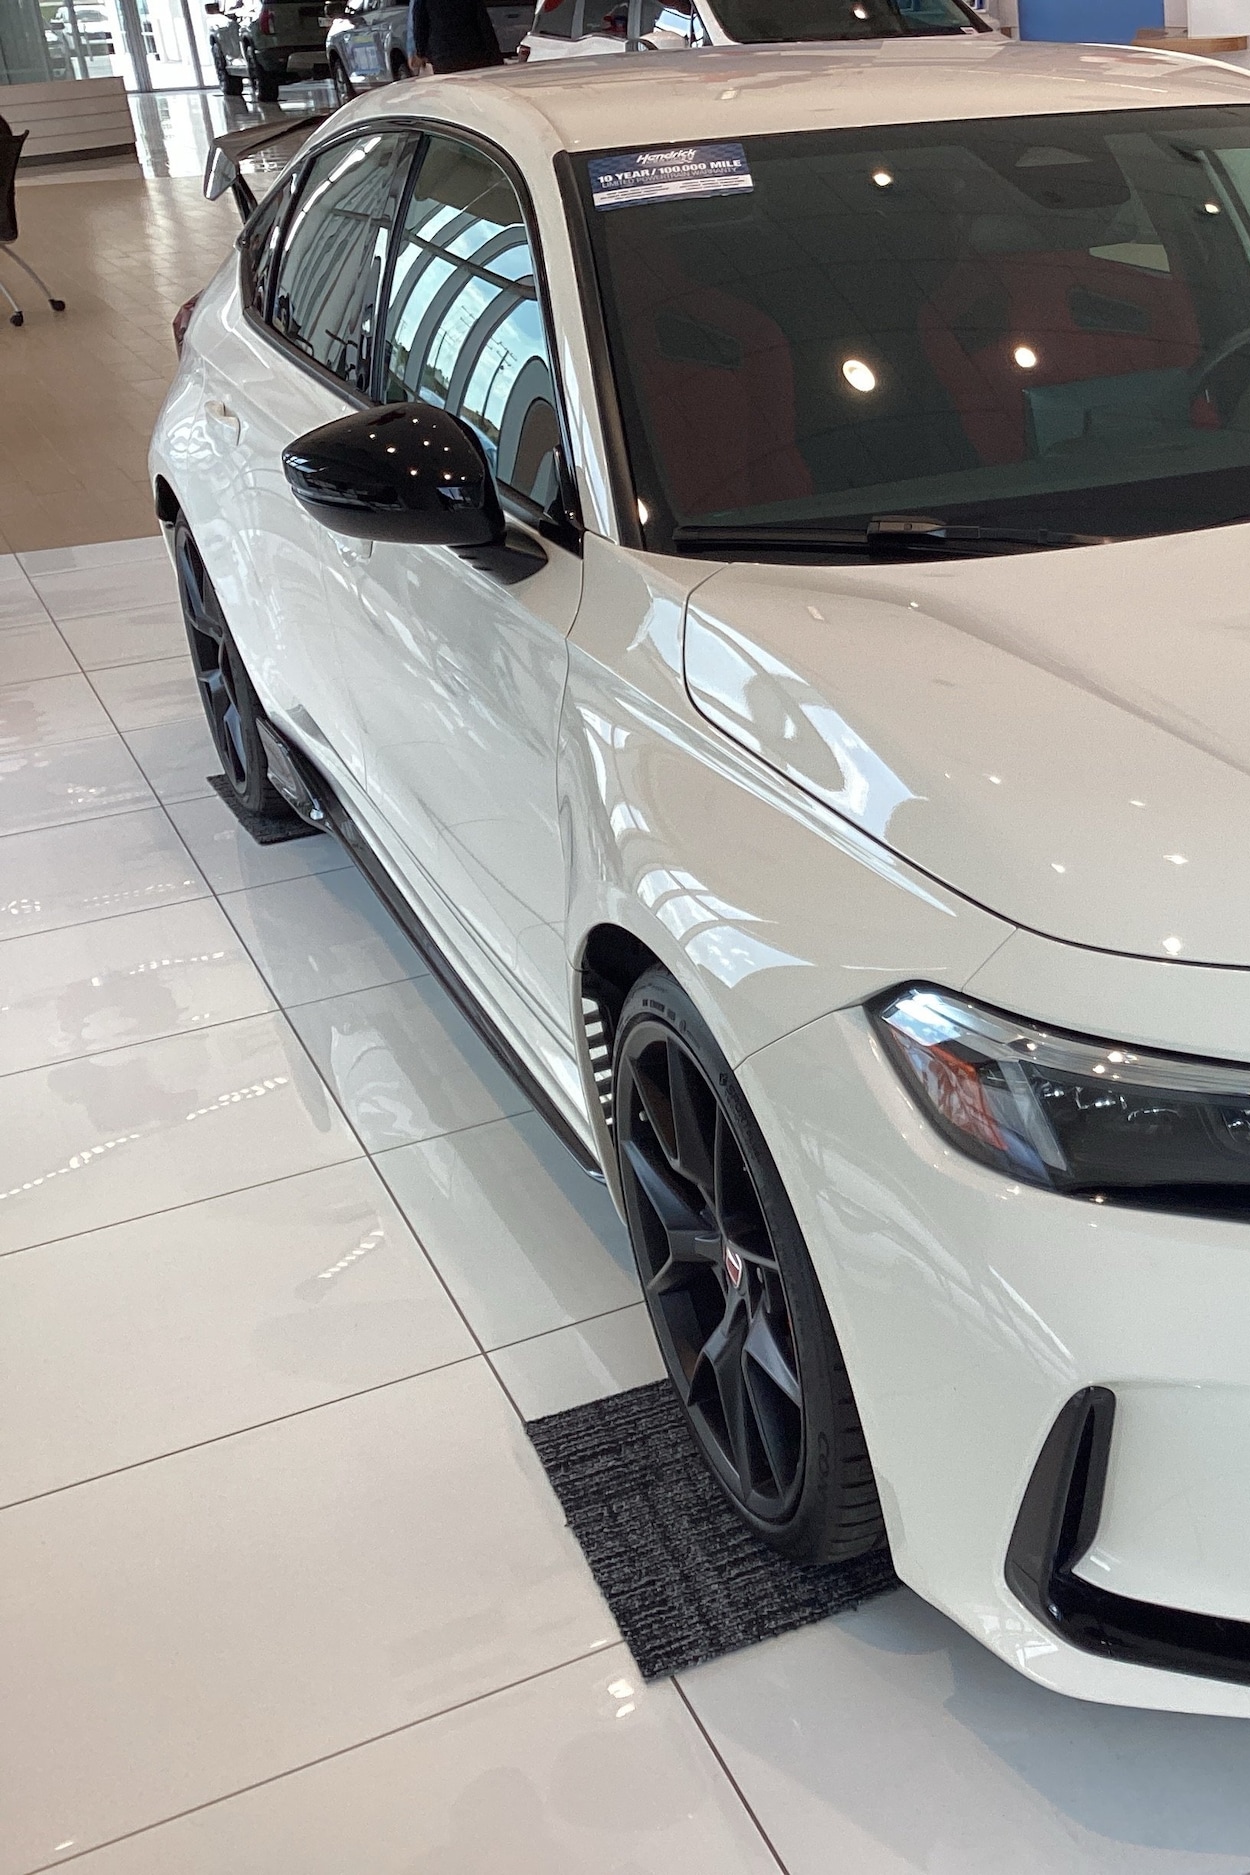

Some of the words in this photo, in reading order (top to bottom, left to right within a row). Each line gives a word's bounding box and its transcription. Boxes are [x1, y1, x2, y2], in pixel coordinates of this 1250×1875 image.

[636, 149, 697, 165] Hendrick
[598, 175, 613, 184] 10
[613, 168, 650, 181] YEAR
[710, 159, 742, 169] MILE
[602, 178, 635, 189] LIMITED
[636, 172, 691, 184] POWERTRAIN
[692, 166, 738, 177] WARRANTY
